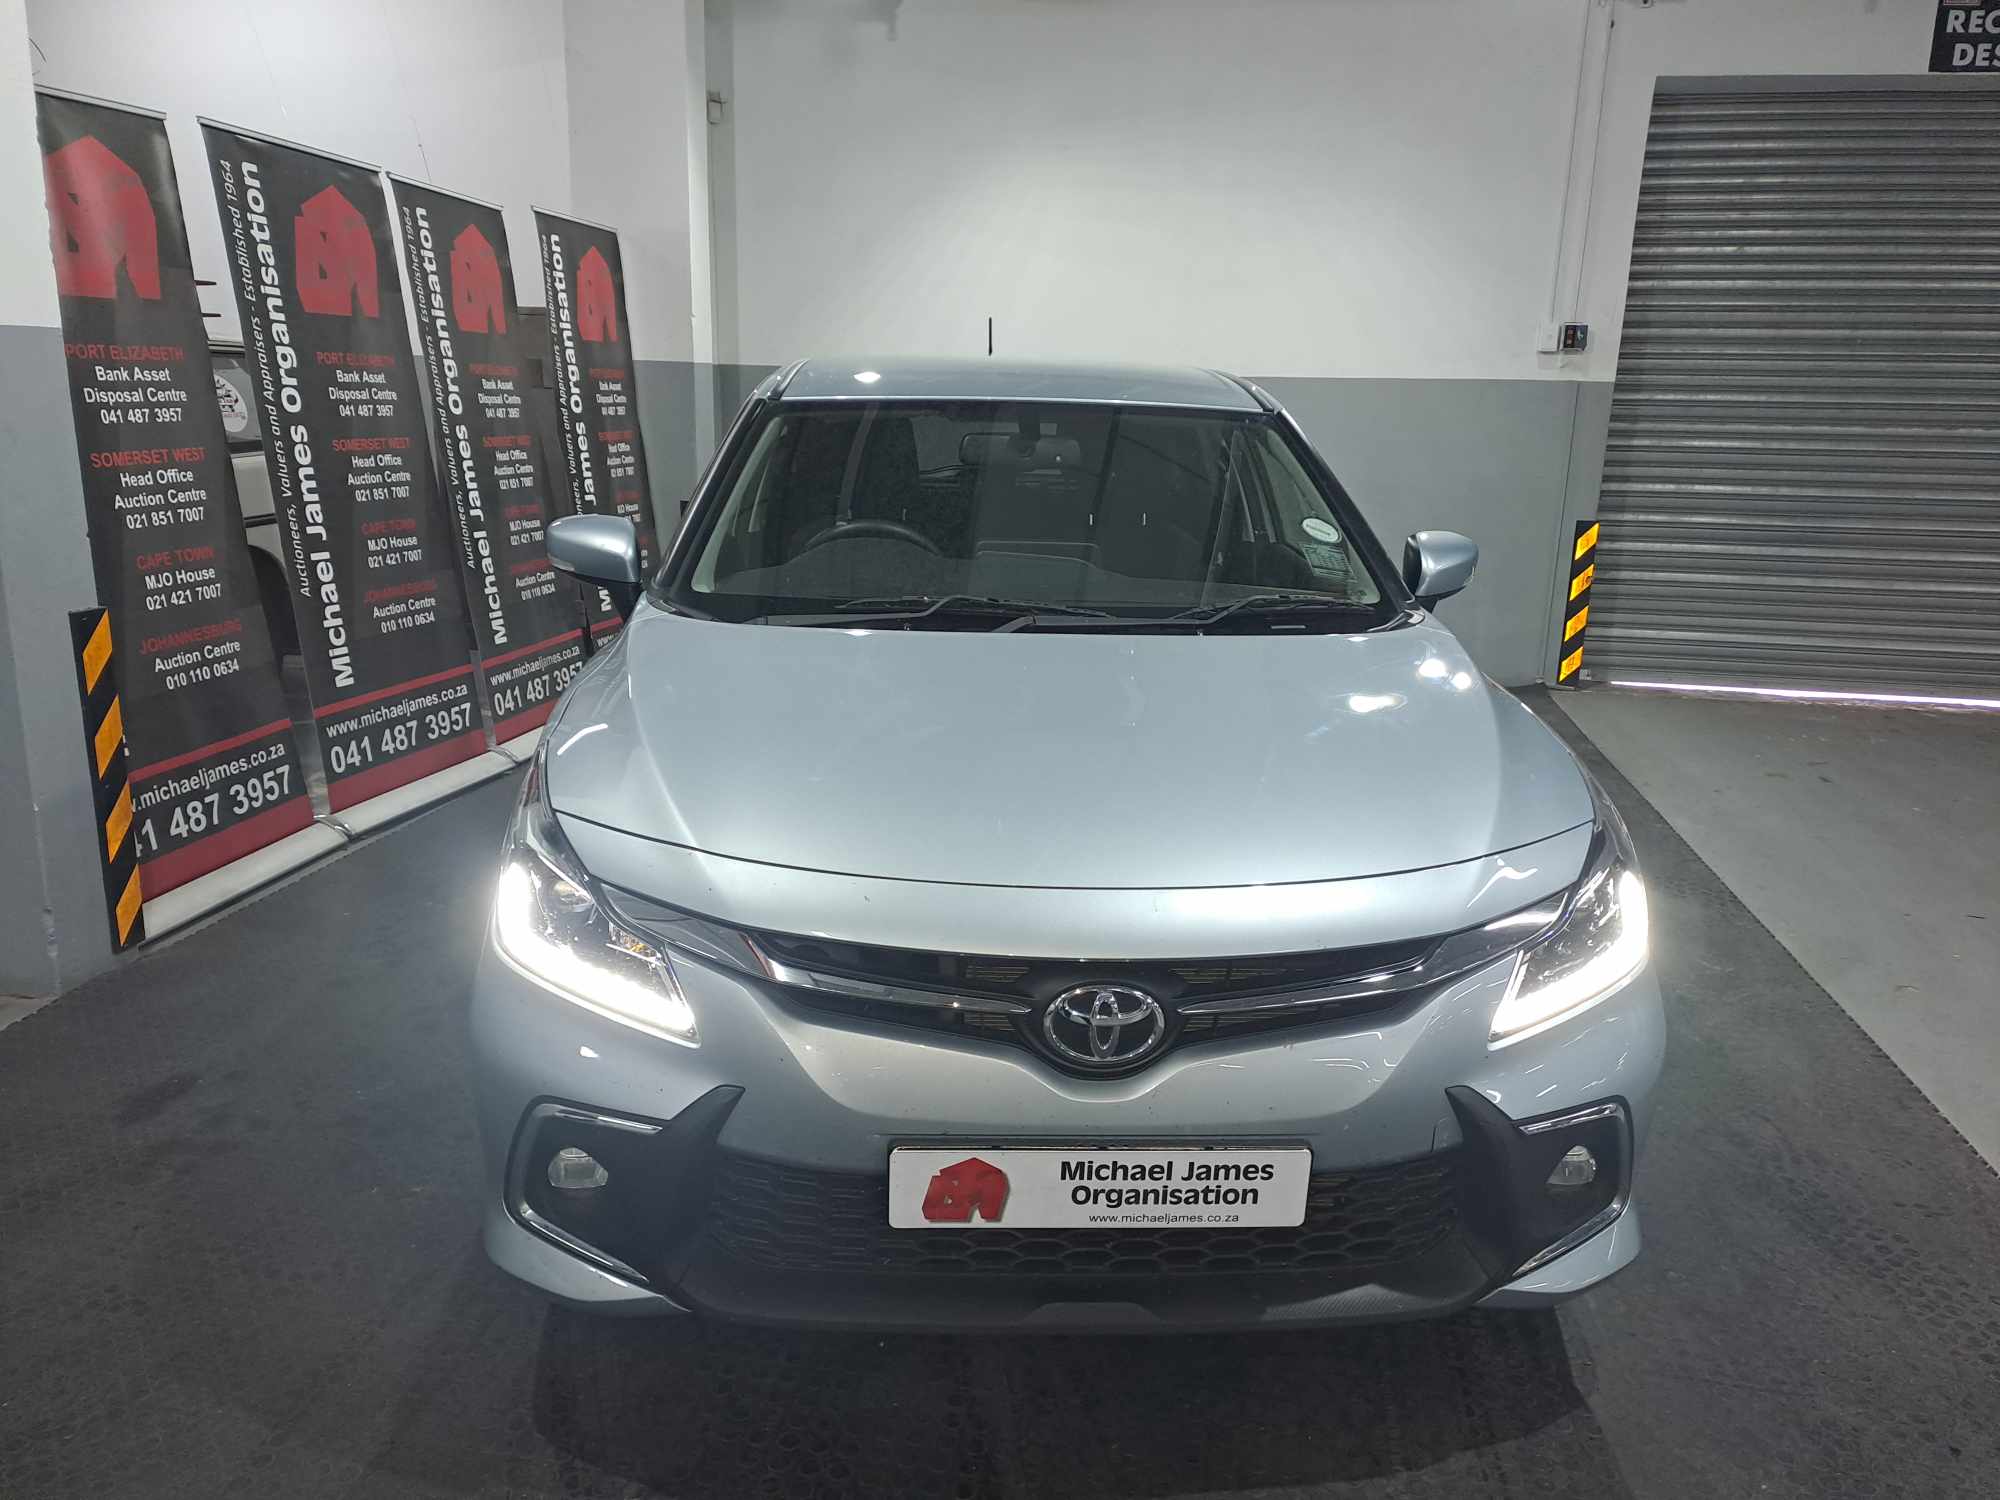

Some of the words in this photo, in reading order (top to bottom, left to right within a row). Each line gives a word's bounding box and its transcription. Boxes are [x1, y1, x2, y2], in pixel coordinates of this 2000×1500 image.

[220, 159, 238, 201] 1964
[227, 205, 256, 301] Established
[241, 161, 302, 414] Organisation
[408, 243, 430, 323] Established
[415, 206, 463, 415] Organisation
[550, 234, 583, 414] Organisation
[64, 342, 109, 360] PORT
[251, 317, 275, 401] Appraisers
[95, 365, 130, 381] Bank
[133, 367, 171, 381] Asset
[336, 369, 360, 383] Bank
[363, 370, 386, 383] Asset
[426, 335, 444, 406] Appraisers
[83, 387, 144, 406] Disposal
[146, 387, 188, 402] Centre
[328, 387, 369, 402] Disposal
[371, 388, 398, 401] Centre
[100, 408, 124, 424] 041
[127, 408, 150, 423] 487
[155, 408, 182, 422] 3957
[264, 404, 281, 436] and
[339, 405, 355, 417] 041
[358, 405, 374, 417] 487
[437, 407, 450, 434] and
[90, 449, 169, 468] SOMERSET
[173, 447, 206, 463] WEST
[274, 440, 292, 498] Valuers
[351, 455, 375, 468] Head
[376, 454, 402, 466] Office
[444, 437, 459, 486] Valuers
[576, 421, 597, 506] James
[120, 471, 153, 488] Head
[156, 468, 194, 484] Office
[289, 424, 327, 541] James
[347, 473, 383, 486] Auction
[384, 470, 412, 483] Centre
[455, 424, 485, 522] James
[114, 493, 165, 511] Auction
[168, 488, 207, 504] Centre
[355, 489, 371, 502] 021
[373, 488, 389, 500] 851
[391, 486, 410, 498] 7007
[126, 514, 148, 530] 021
[152, 512, 174, 527] 851
[178, 507, 204, 523] 7007
[455, 489, 476, 569] Auctioneers,
[286, 503, 312, 597] Auctioneers,
[367, 538, 388, 551] MJO
[389, 536, 418, 548] House
[136, 552, 172, 571] CAPE
[367, 556, 384, 568] 021
[385, 553, 401, 566] 421
[403, 549, 422, 562] 7007
[144, 572, 173, 590] MJO
[176, 568, 216, 585] House
[473, 530, 508, 645] Michael
[145, 596, 168, 611] 021
[171, 589, 193, 606] 421
[195, 583, 222, 601] 7007
[373, 602, 407, 619] Auction
[408, 597, 436, 611] Centre
[310, 551, 355, 688] Michael
[381, 620, 397, 634] 010
[398, 615, 413, 629] 110
[414, 610, 436, 626] 0634
[155, 653, 202, 673] Auction
[204, 641, 241, 659] Centre
[166, 672, 187, 690] 010
[190, 666, 211, 683] 110
[213, 658, 240, 677] 0634
[494, 685, 523, 716] 041
[526, 674, 550, 702] 487
[326, 683, 468, 739] www.michaeljames.co.za
[330, 735, 374, 774] 041
[380, 719, 418, 755] 487
[424, 702, 471, 740] 3957
[169, 793, 219, 839] 487
[229, 765, 290, 815] 3957
[1059, 1160, 1174, 1182] Michael
[1181, 1160, 1274, 1182] James
[1071, 1185, 1259, 1208] Organisation
[1089, 1213, 1239, 1225] www.michaeljames.co.za
